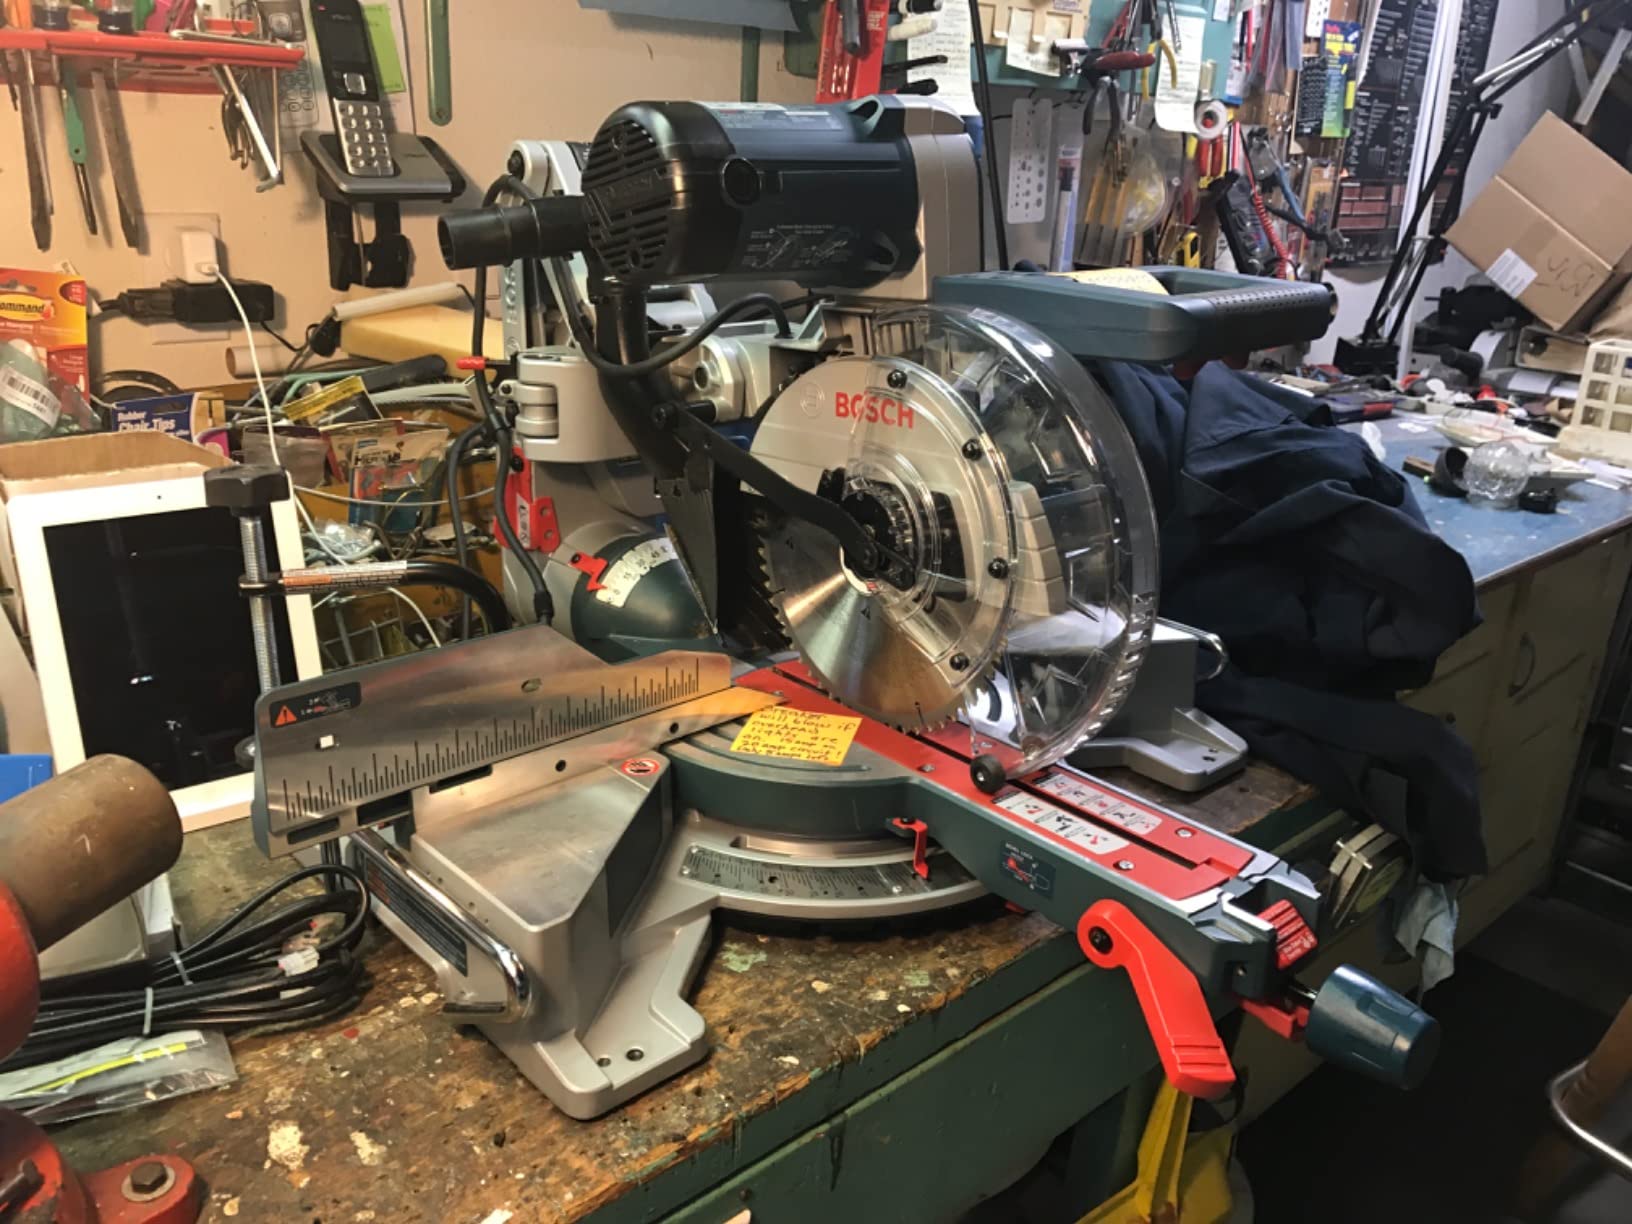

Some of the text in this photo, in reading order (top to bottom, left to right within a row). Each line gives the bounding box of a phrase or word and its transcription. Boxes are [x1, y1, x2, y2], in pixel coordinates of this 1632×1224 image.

[0, 301, 45, 314] ommand
[117, 411, 147, 422] Rubber
[835, 391, 914, 429] BOSCH
[152, 417, 176, 433] Tips
